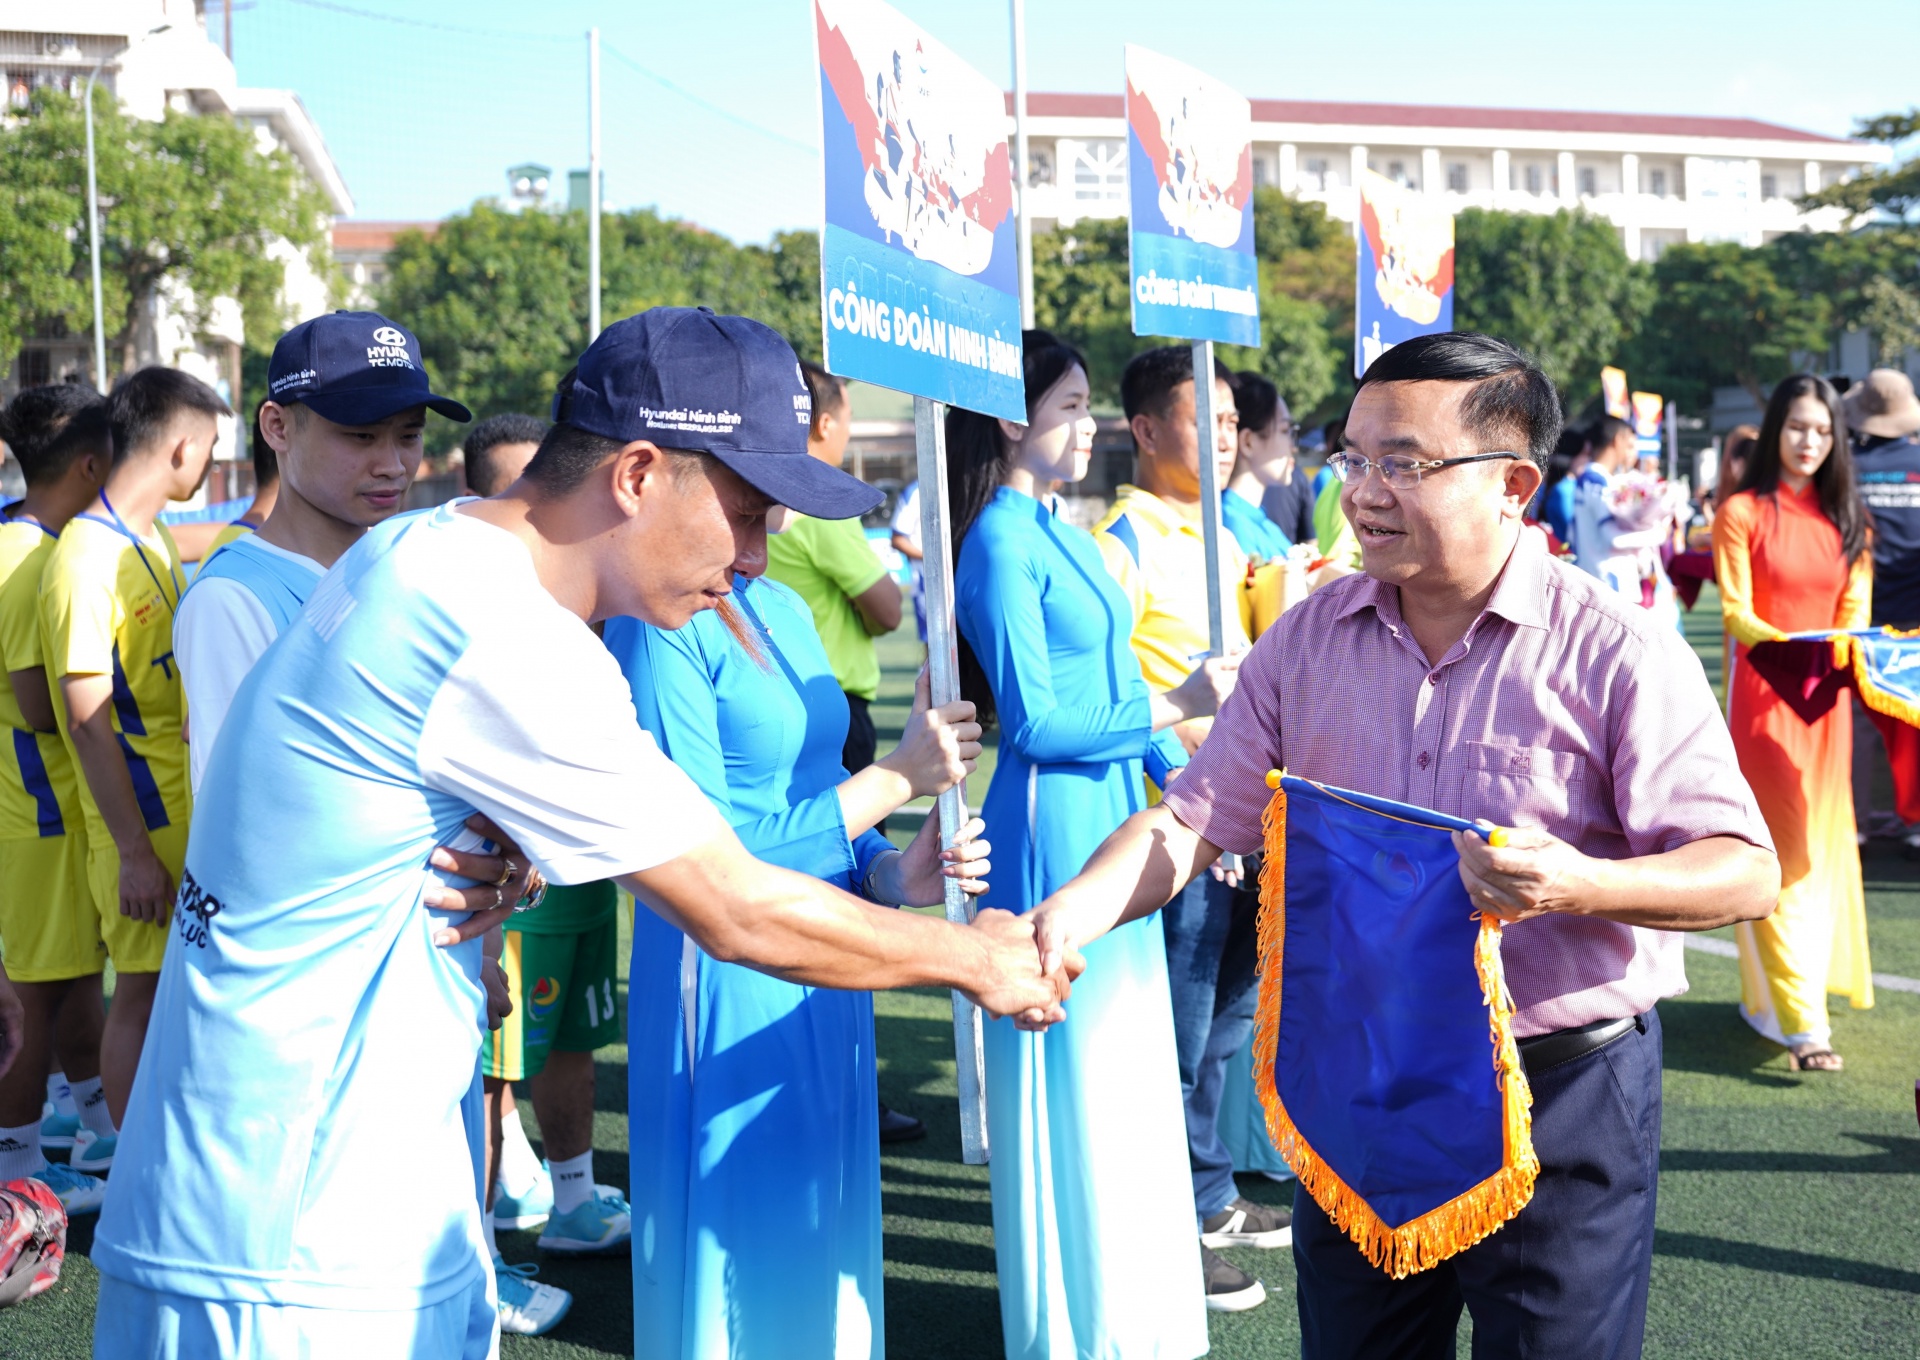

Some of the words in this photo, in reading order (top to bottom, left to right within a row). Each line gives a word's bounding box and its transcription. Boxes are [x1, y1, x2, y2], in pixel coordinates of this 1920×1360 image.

[829, 280, 891, 343] CÔNG
[893, 304, 947, 359] ĐOÀN
[948, 323, 988, 370] NINH
[988, 329, 1022, 380] BÌNH
[639, 406, 688, 422] Hyundai
[688, 408, 716, 424] Ninh
[717, 409, 742, 425] Bình
